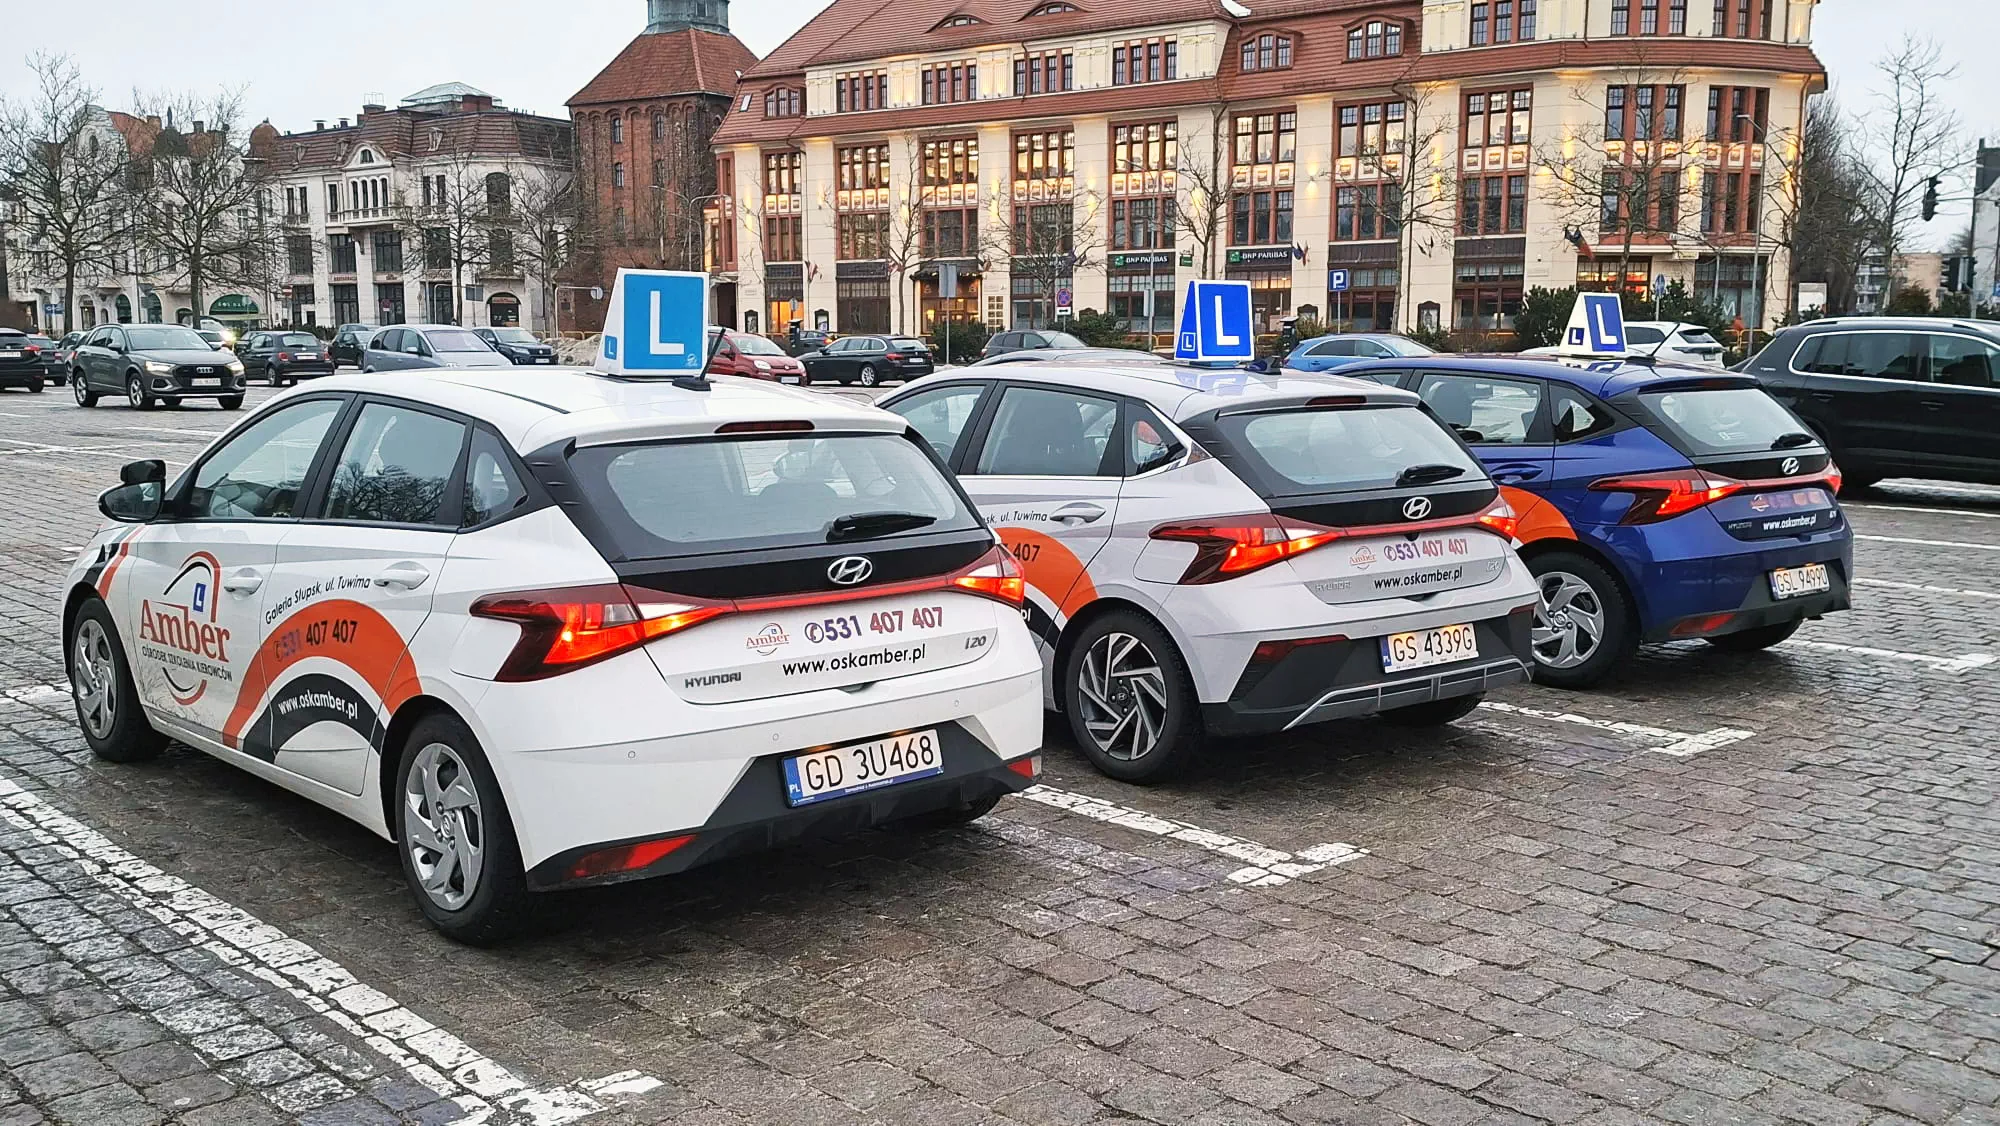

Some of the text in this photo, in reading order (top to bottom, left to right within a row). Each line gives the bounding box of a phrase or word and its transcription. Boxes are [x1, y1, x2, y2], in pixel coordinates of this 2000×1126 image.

[1242, 251, 1288, 260] BNP PARIBAS
[1333, 272, 1344, 289] P
[650, 291, 684, 355] L
[1215, 295, 1240, 346] L
[1595, 303, 1618, 345] L
[608, 340, 615, 355] L
[1186, 335, 1193, 349] L
[1571, 329, 1581, 344] L
[1013, 511, 1048, 522] Tuwima
[1763, 513, 1817, 531] www.oskamber.pl
[1396, 538, 1468, 560] 531 407 407
[1374, 565, 1463, 589] www.oskamber.pl
[1776, 567, 1828, 593] GSL 94990
[265, 596, 292, 625] Galeria
[325, 577, 335, 592] ul.
[337, 574, 371, 590] Tuwima
[139, 599, 230, 663] Amber
[306, 620, 328, 646] 407
[332, 618, 358, 643] 407
[824, 606, 943, 642] 531 407 407
[746, 634, 790, 647] Amber
[964, 635, 987, 650] i20
[1393, 635, 1418, 662] GS
[1424, 626, 1473, 657] 4339G
[142, 644, 233, 682] OŚRODEK SZKOLENIA KIEROWCÓW
[782, 643, 926, 676] www.oskamber.pl
[684, 671, 742, 688] HYUNDAI
[278, 689, 358, 720] www.oskamber.pl
[805, 735, 934, 790] GD 3U468
[788, 783, 801, 794] PL
